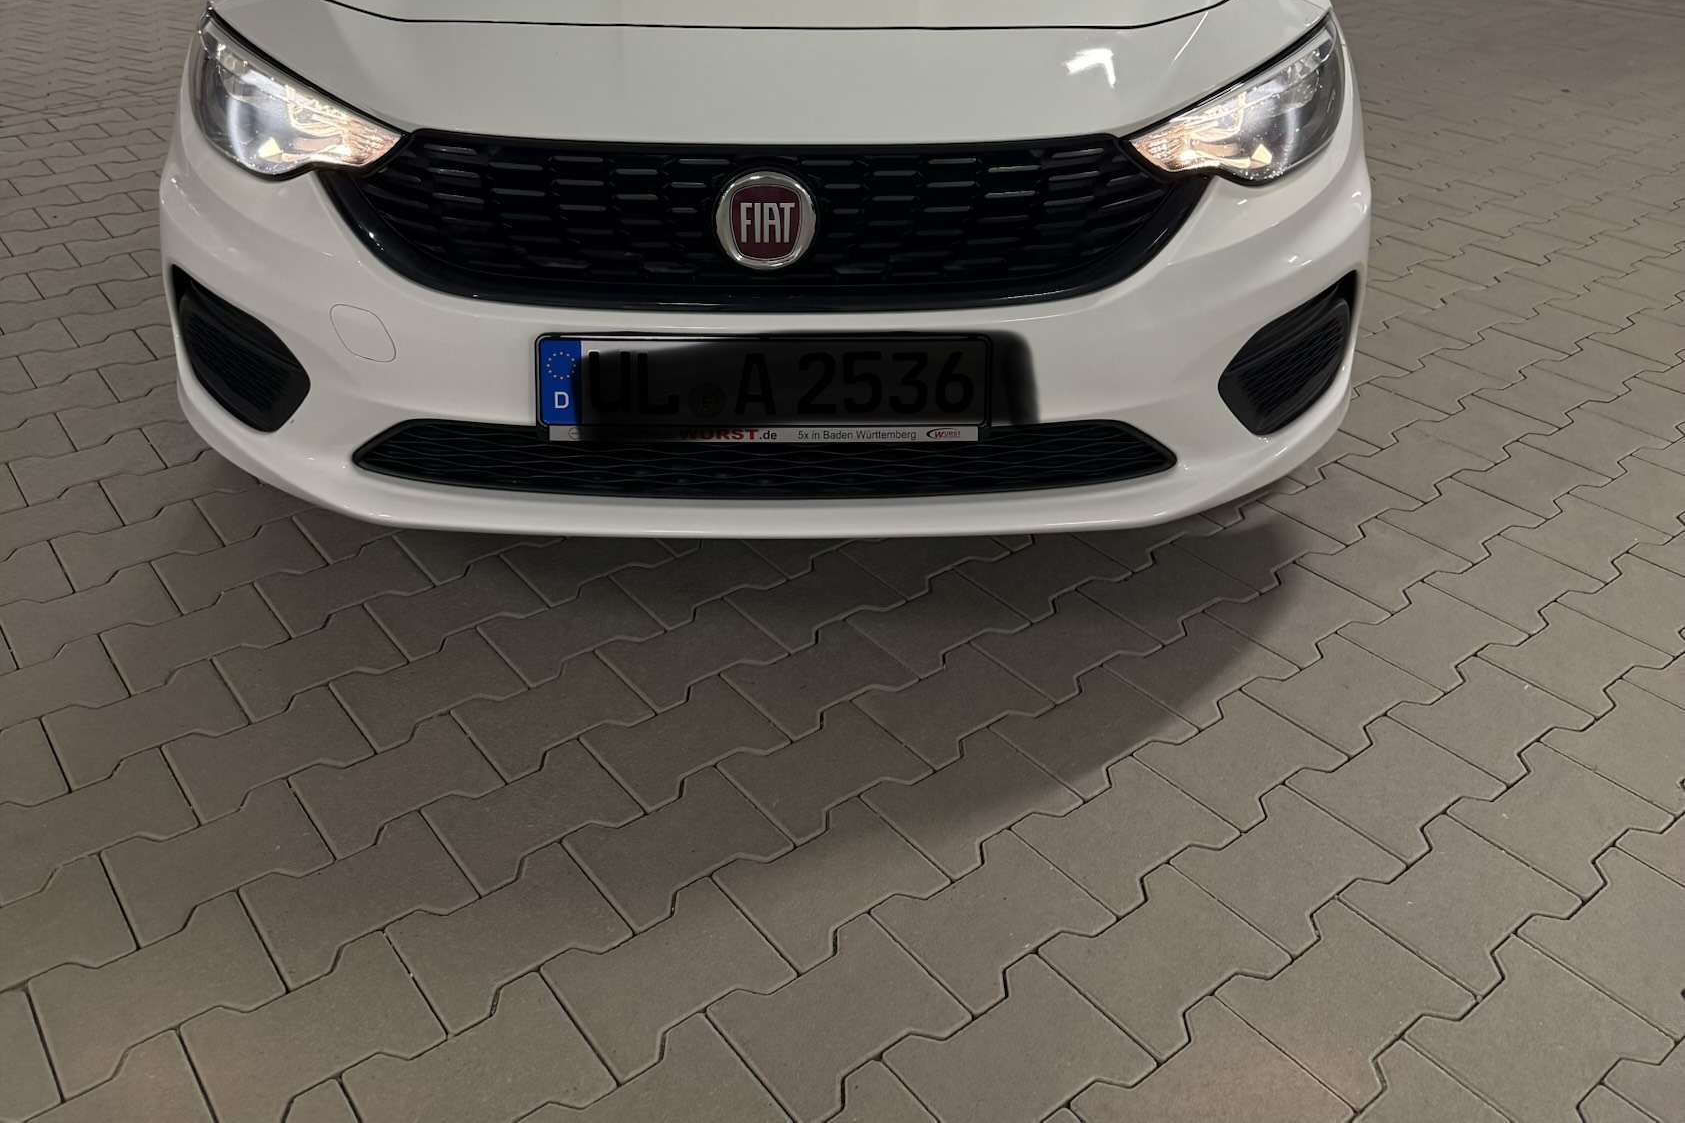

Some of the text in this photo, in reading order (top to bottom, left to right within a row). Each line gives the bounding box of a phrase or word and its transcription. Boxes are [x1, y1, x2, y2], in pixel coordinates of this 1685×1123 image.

[740, 202, 796, 244] FIAT
[734, 353, 776, 413] A
[797, 351, 974, 413] 2536
[554, 391, 569, 408] D
[798, 429, 917, 442] 5x in Baden Württemberg
